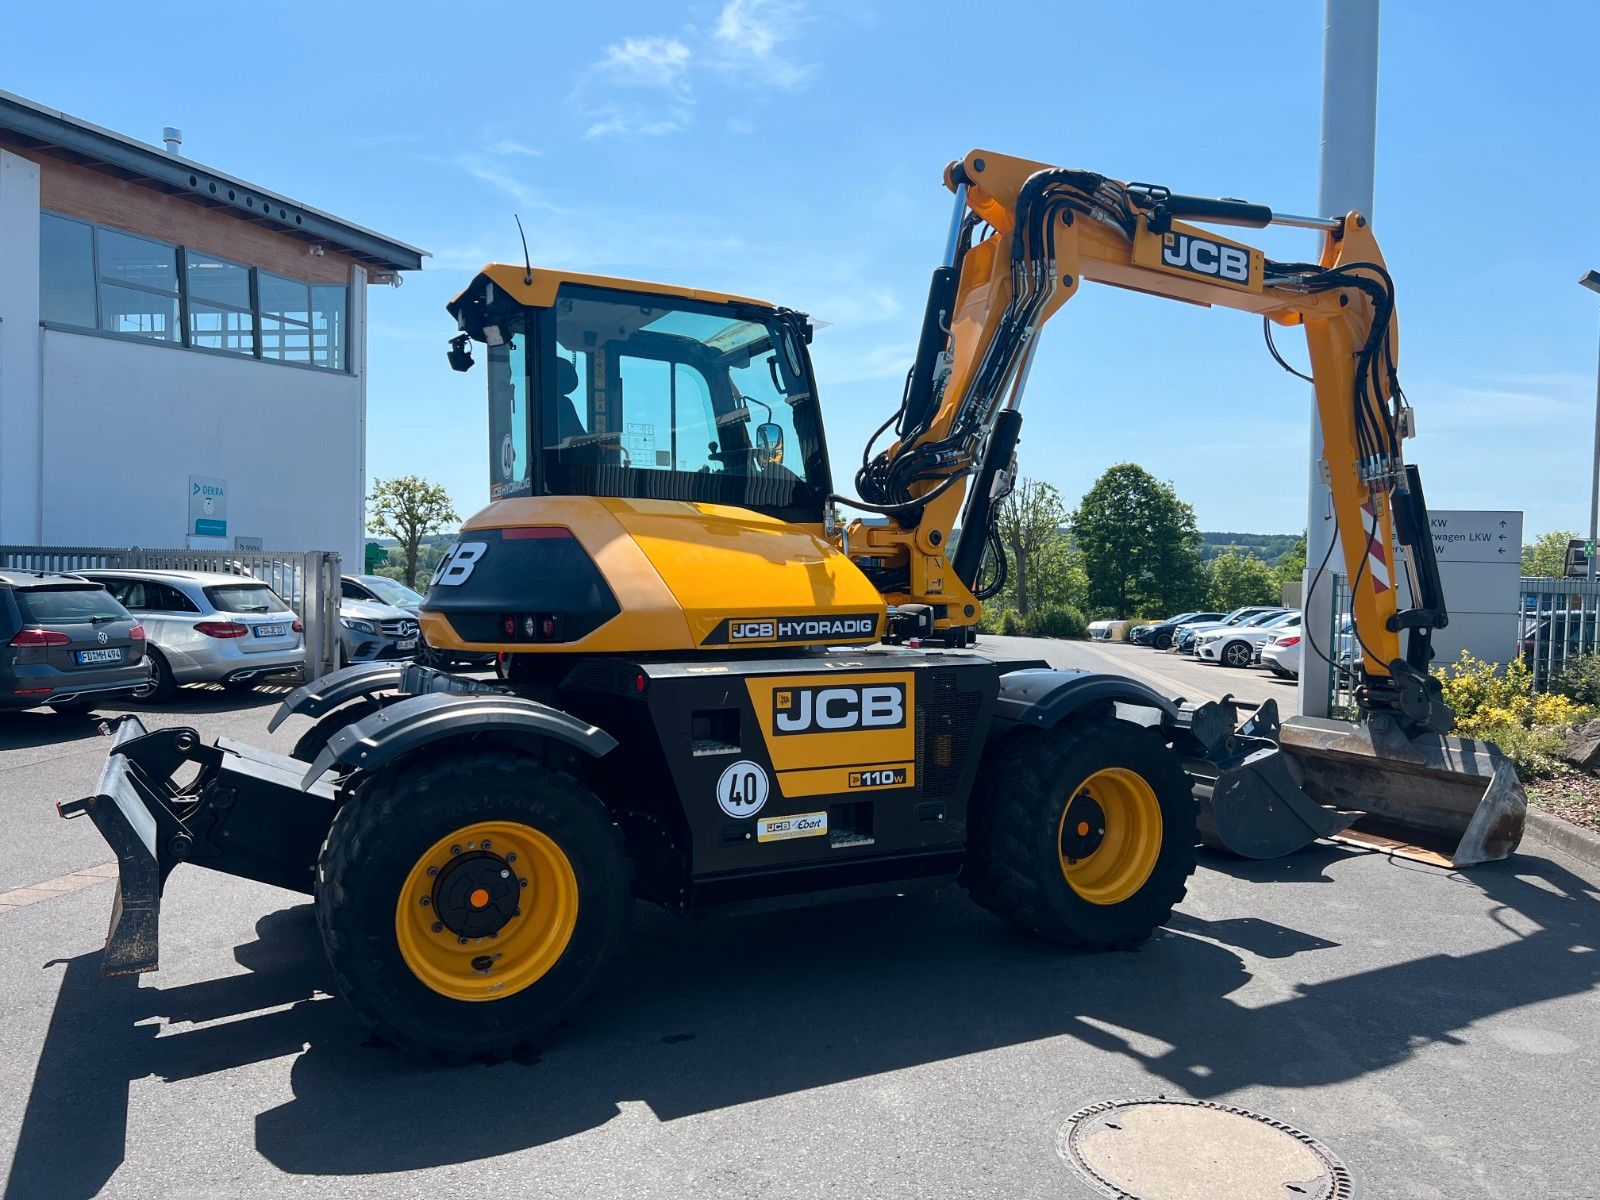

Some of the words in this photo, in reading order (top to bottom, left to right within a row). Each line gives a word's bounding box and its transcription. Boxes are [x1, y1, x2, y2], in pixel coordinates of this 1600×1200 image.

[1164, 236, 1248, 281] JCB
[202, 485, 224, 497] DEKRA
[1430, 519, 1448, 528] KW
[1469, 532, 1492, 542] LKW
[430, 542, 488, 586] CB
[732, 623, 774, 638] JCB
[778, 619, 872, 636] HYDRADIG
[107, 649, 120, 659] 494
[776, 687, 903, 732] JCB
[728, 772, 757, 807] 40
[767, 822, 791, 833] JCB
